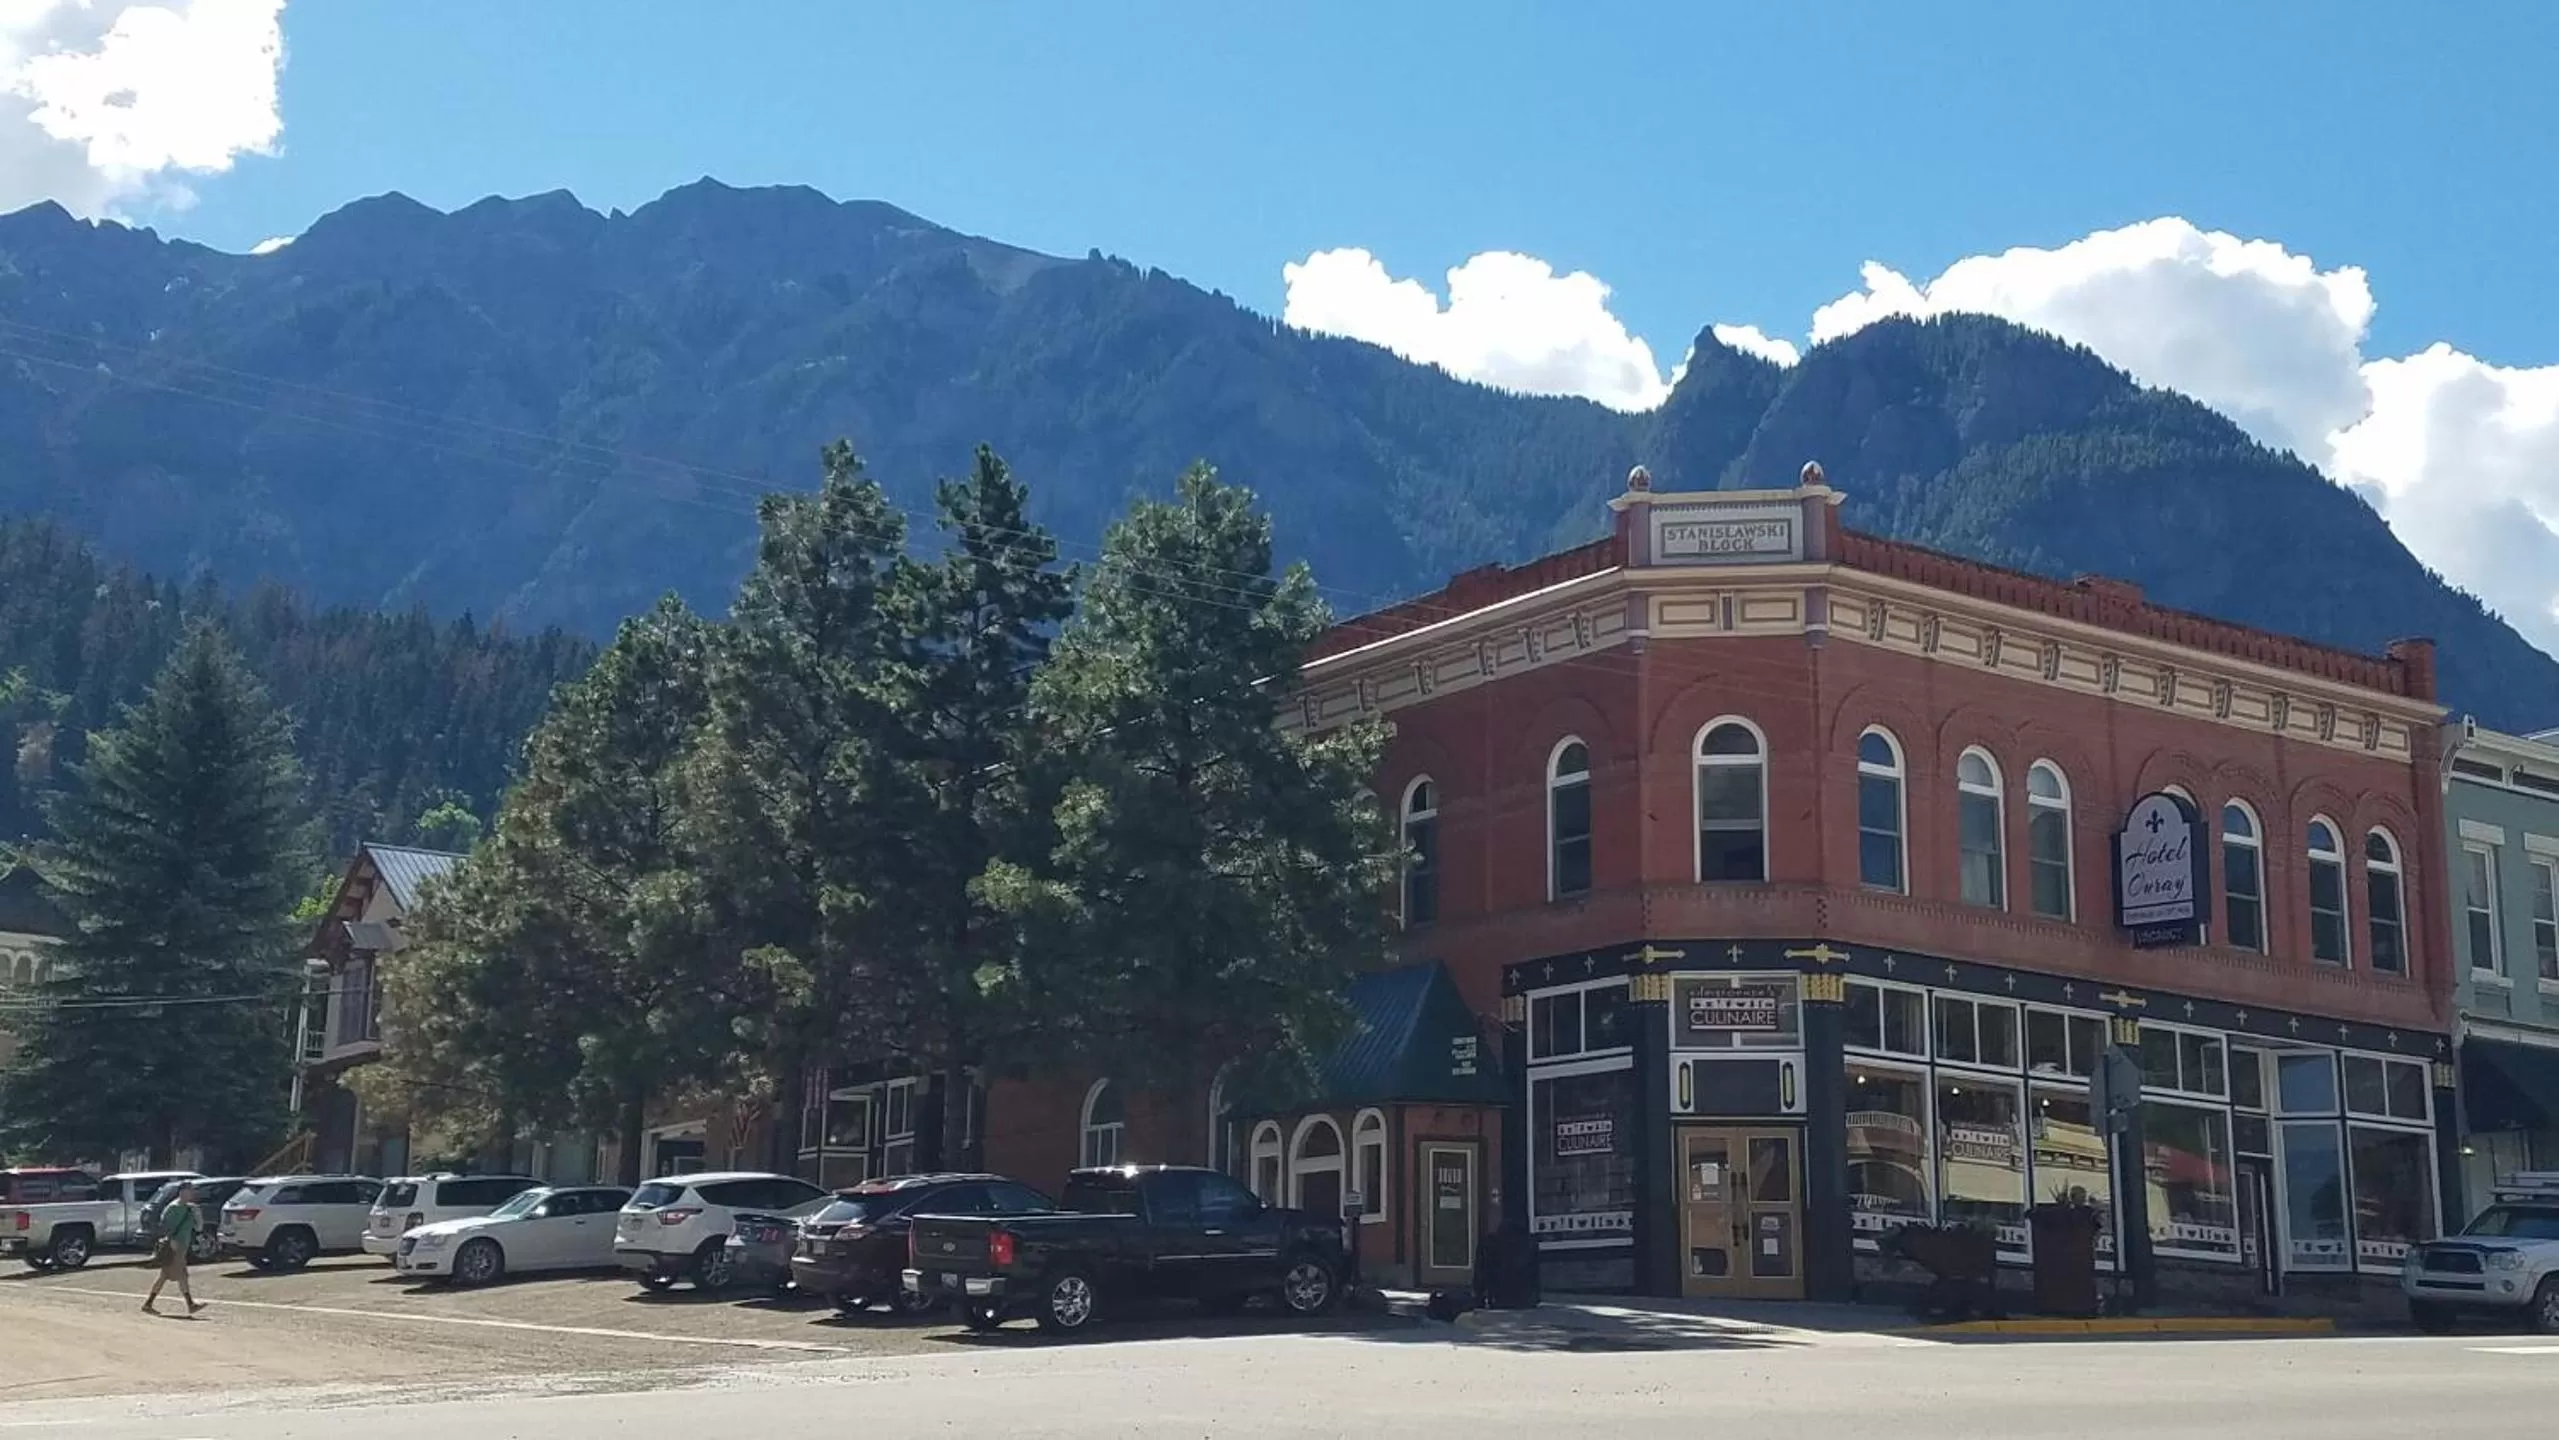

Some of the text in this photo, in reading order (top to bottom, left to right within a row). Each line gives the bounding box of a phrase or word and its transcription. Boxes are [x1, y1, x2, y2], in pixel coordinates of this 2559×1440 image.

[1698, 538, 1754, 551] BLOCK
[2125, 835, 2188, 868] Hotel
[2128, 872, 2186, 899] Ouray
[1690, 1010, 1777, 1025] CULINAIRE
[1558, 1133, 1613, 1151] CULINAIRE
